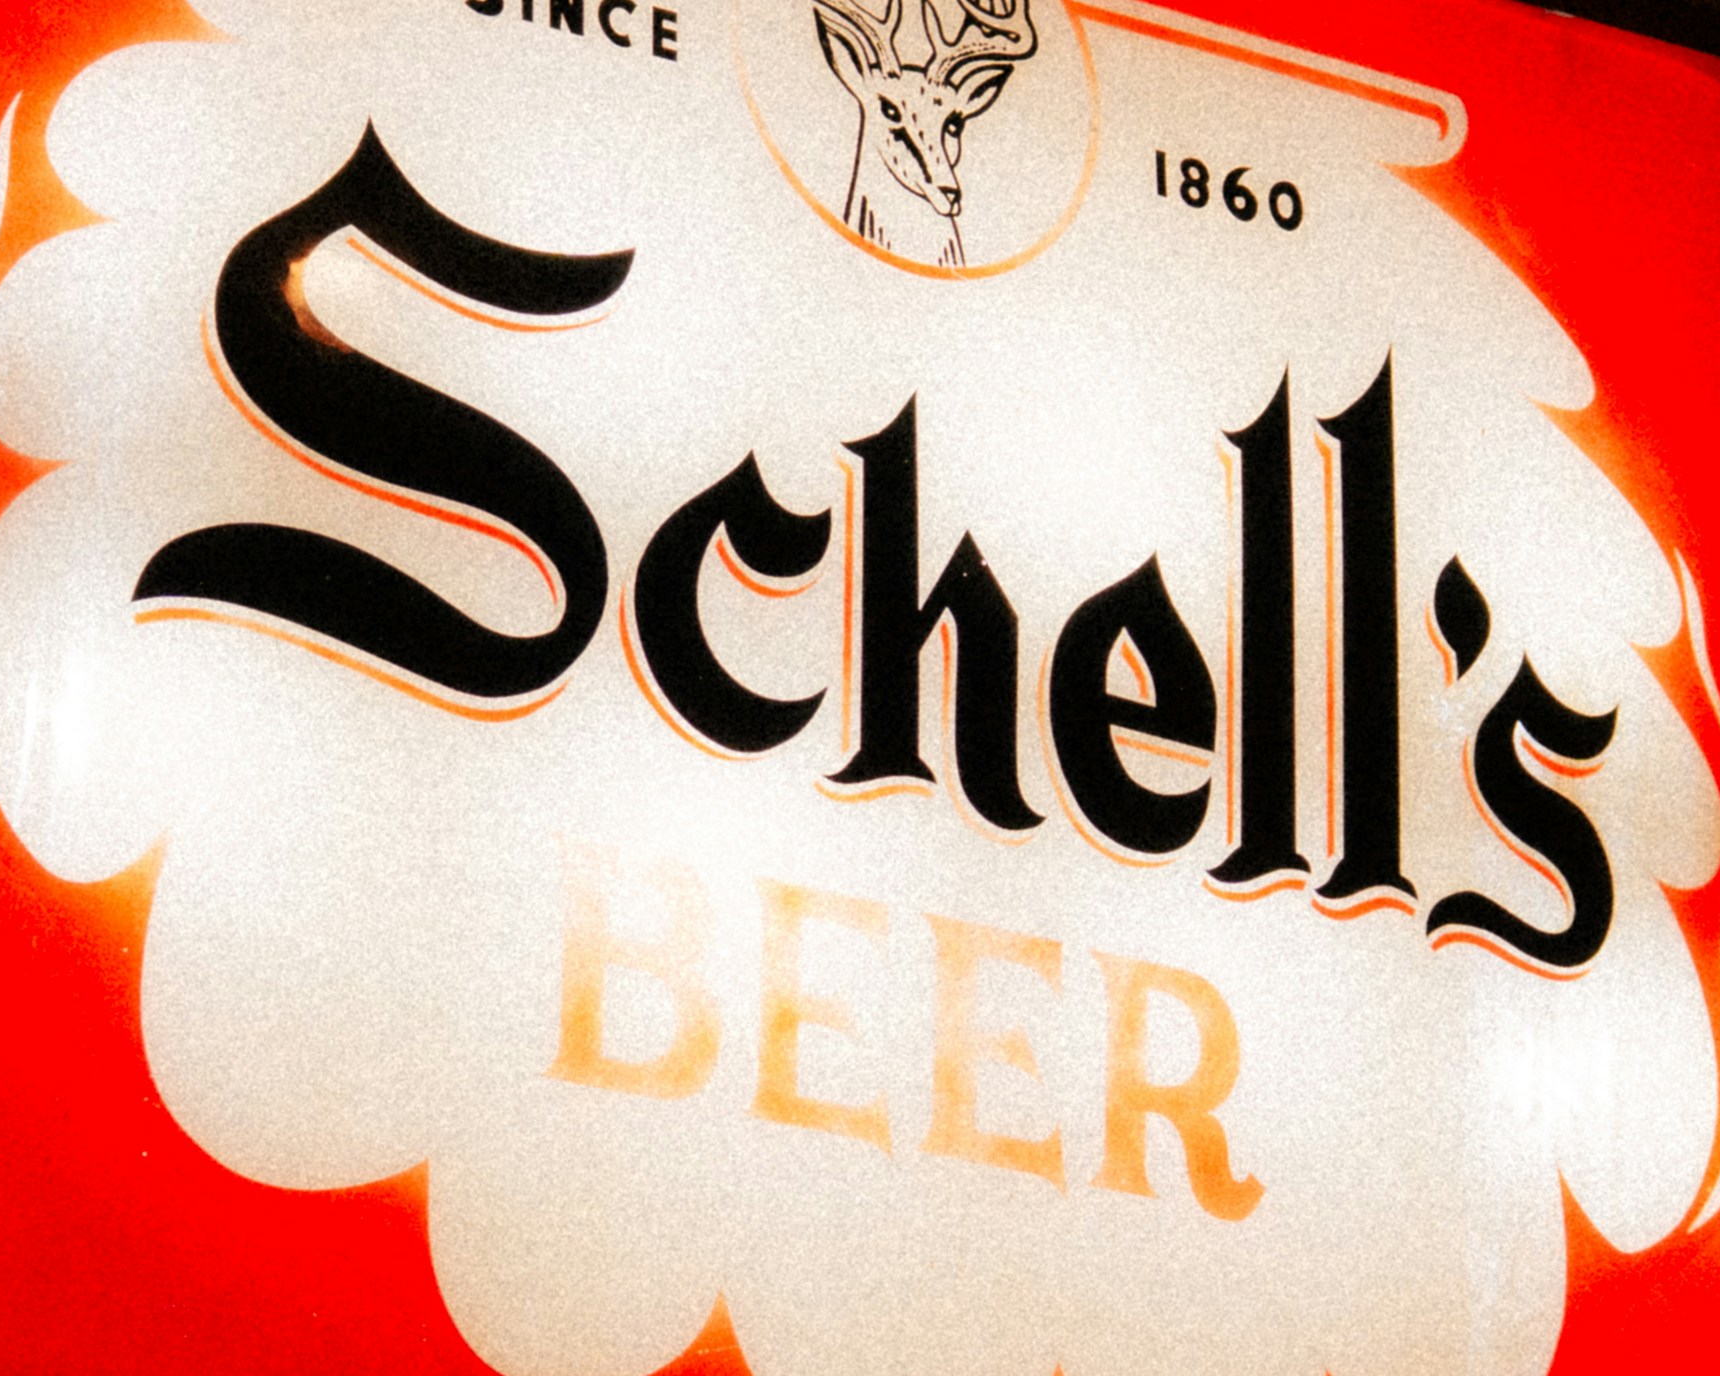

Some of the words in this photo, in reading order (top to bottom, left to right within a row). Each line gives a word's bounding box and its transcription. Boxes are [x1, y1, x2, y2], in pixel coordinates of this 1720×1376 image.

[1153, 150, 1304, 232] 1860
[131, 116, 1620, 976] Schell's
[546, 836, 1266, 1224] BEER
